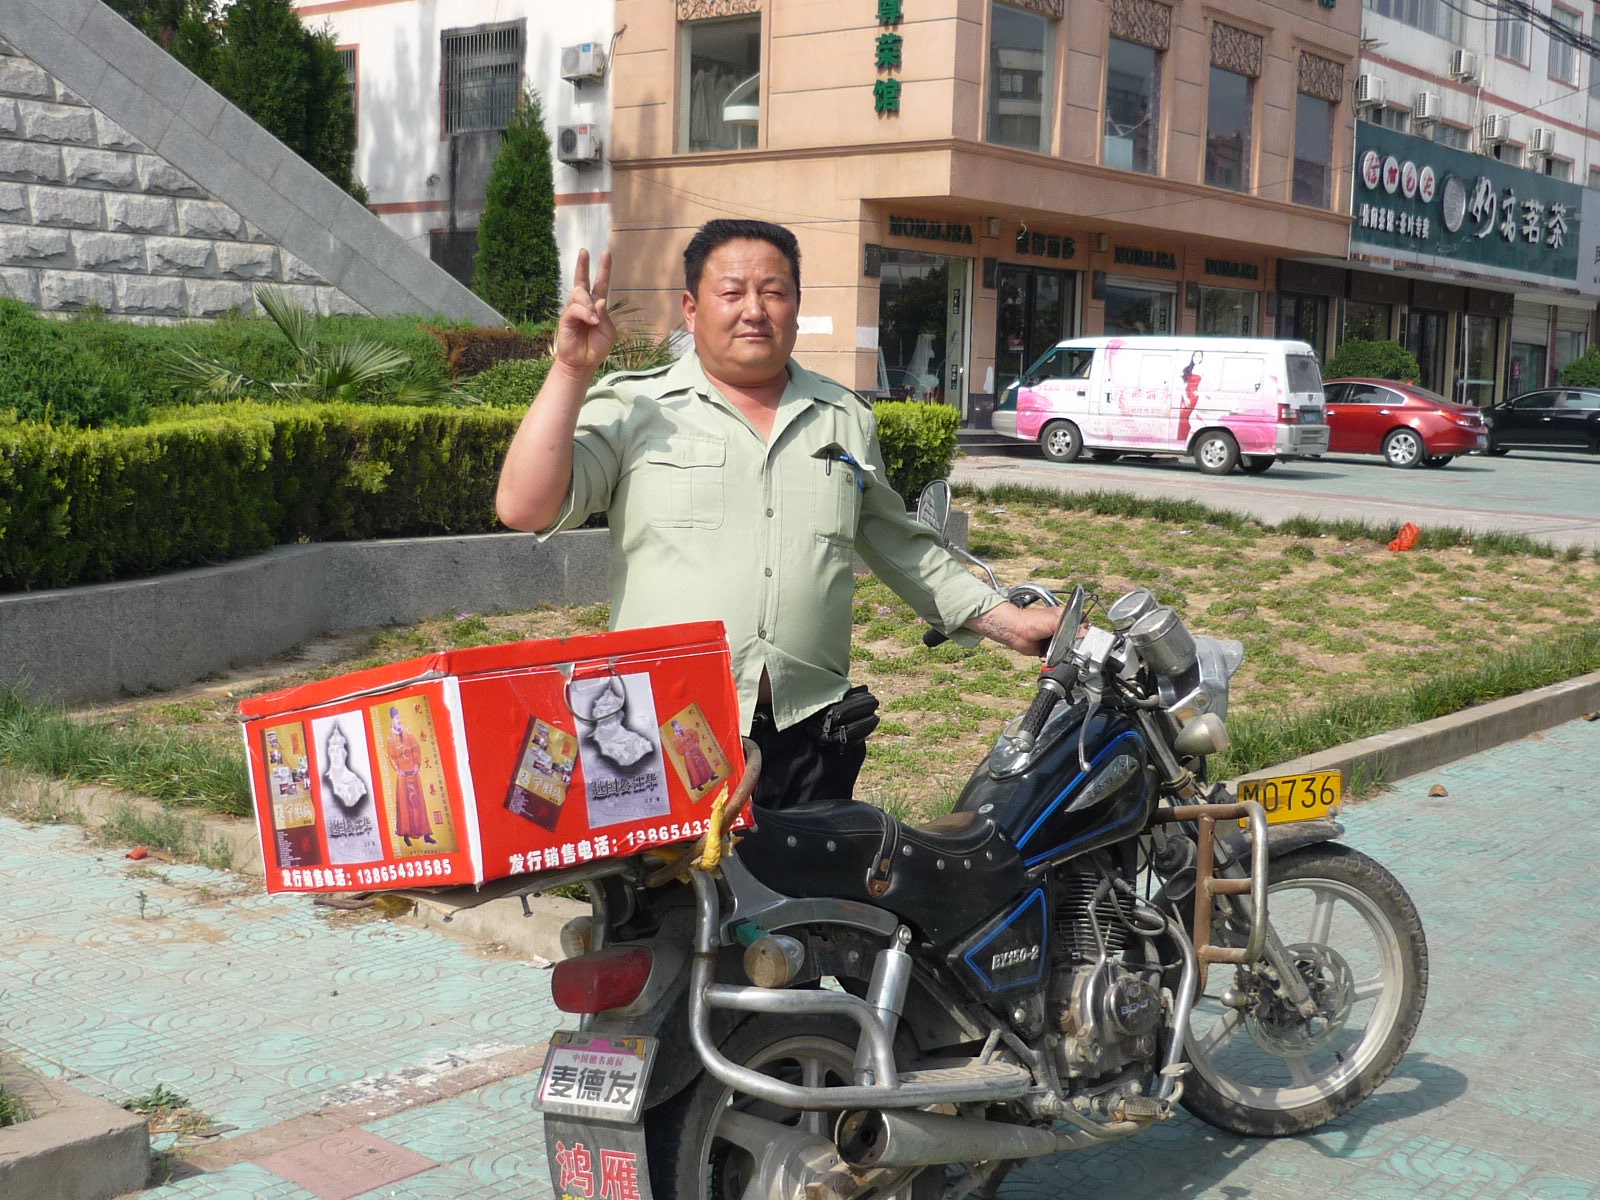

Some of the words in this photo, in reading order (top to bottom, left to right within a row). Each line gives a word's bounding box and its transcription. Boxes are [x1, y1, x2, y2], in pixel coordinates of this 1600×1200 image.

[1243, 776, 1335, 812] M0736
[627, 813, 744, 846] 138654335
[358, 858, 452, 885] 13865433585
[572, 1052, 624, 1066] 中国驰名商标
[548, 1065, 637, 1105] 麦德发
[556, 1140, 640, 1200] 鸿雁
